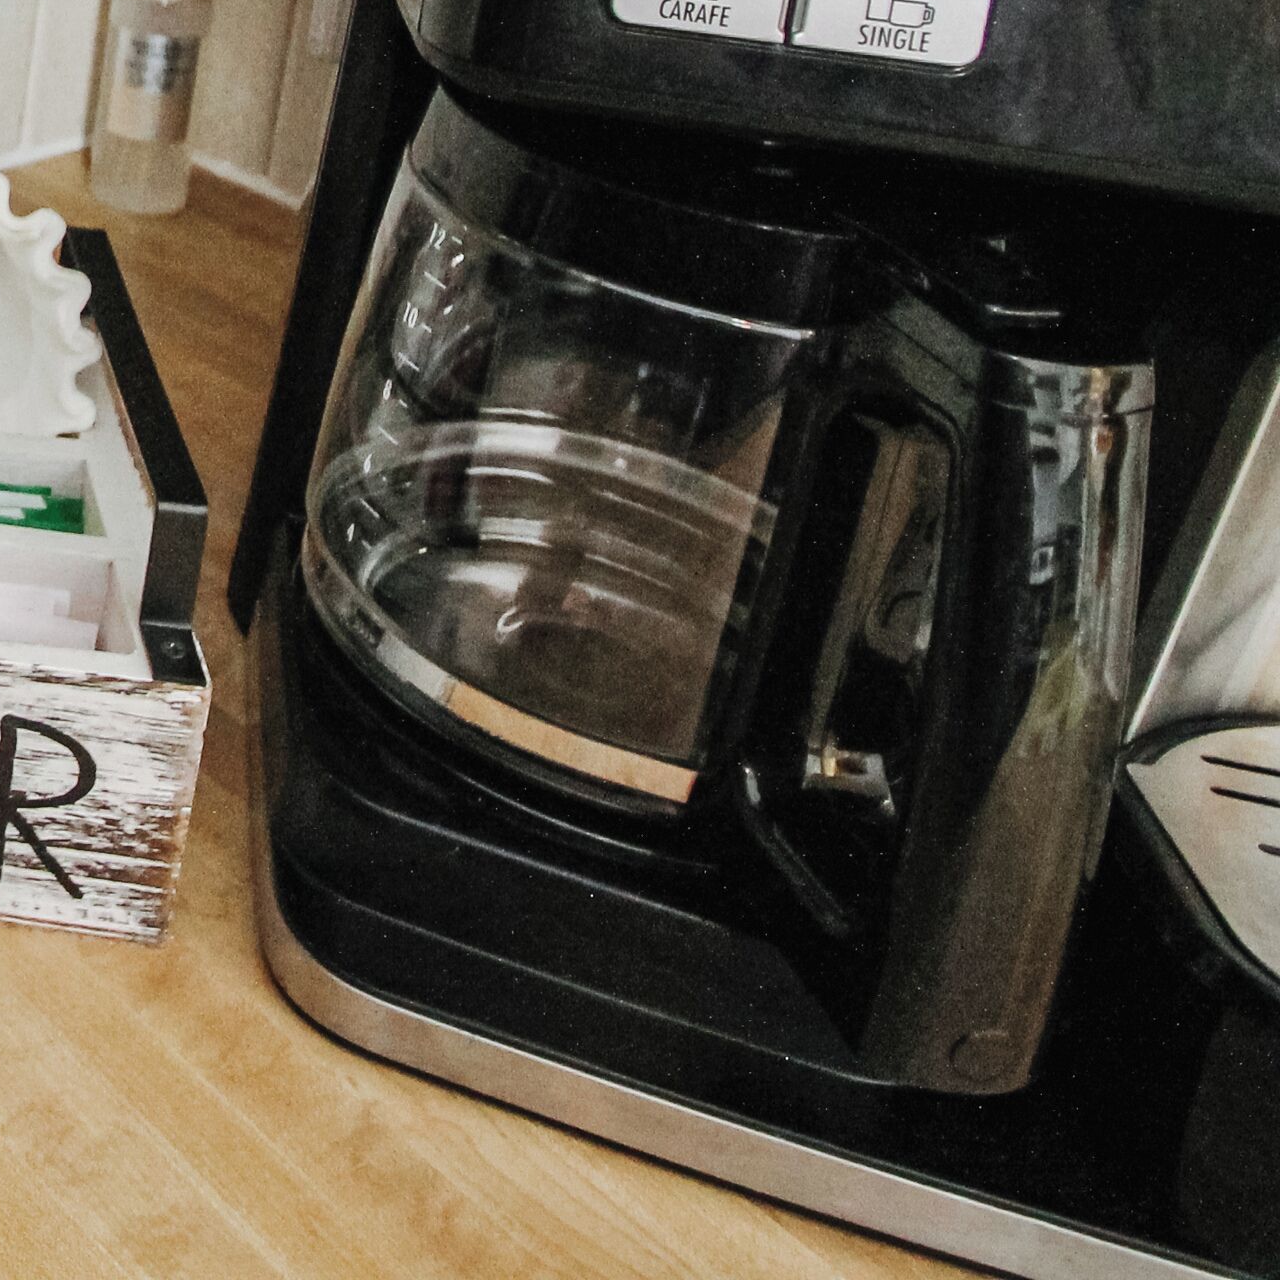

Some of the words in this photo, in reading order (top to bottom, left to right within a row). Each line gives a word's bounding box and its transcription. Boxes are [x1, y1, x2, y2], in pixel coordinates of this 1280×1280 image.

[858, 25, 931, 53] SINGLE
[430, 222, 446, 251] 12
[403, 301, 419, 329] 10
